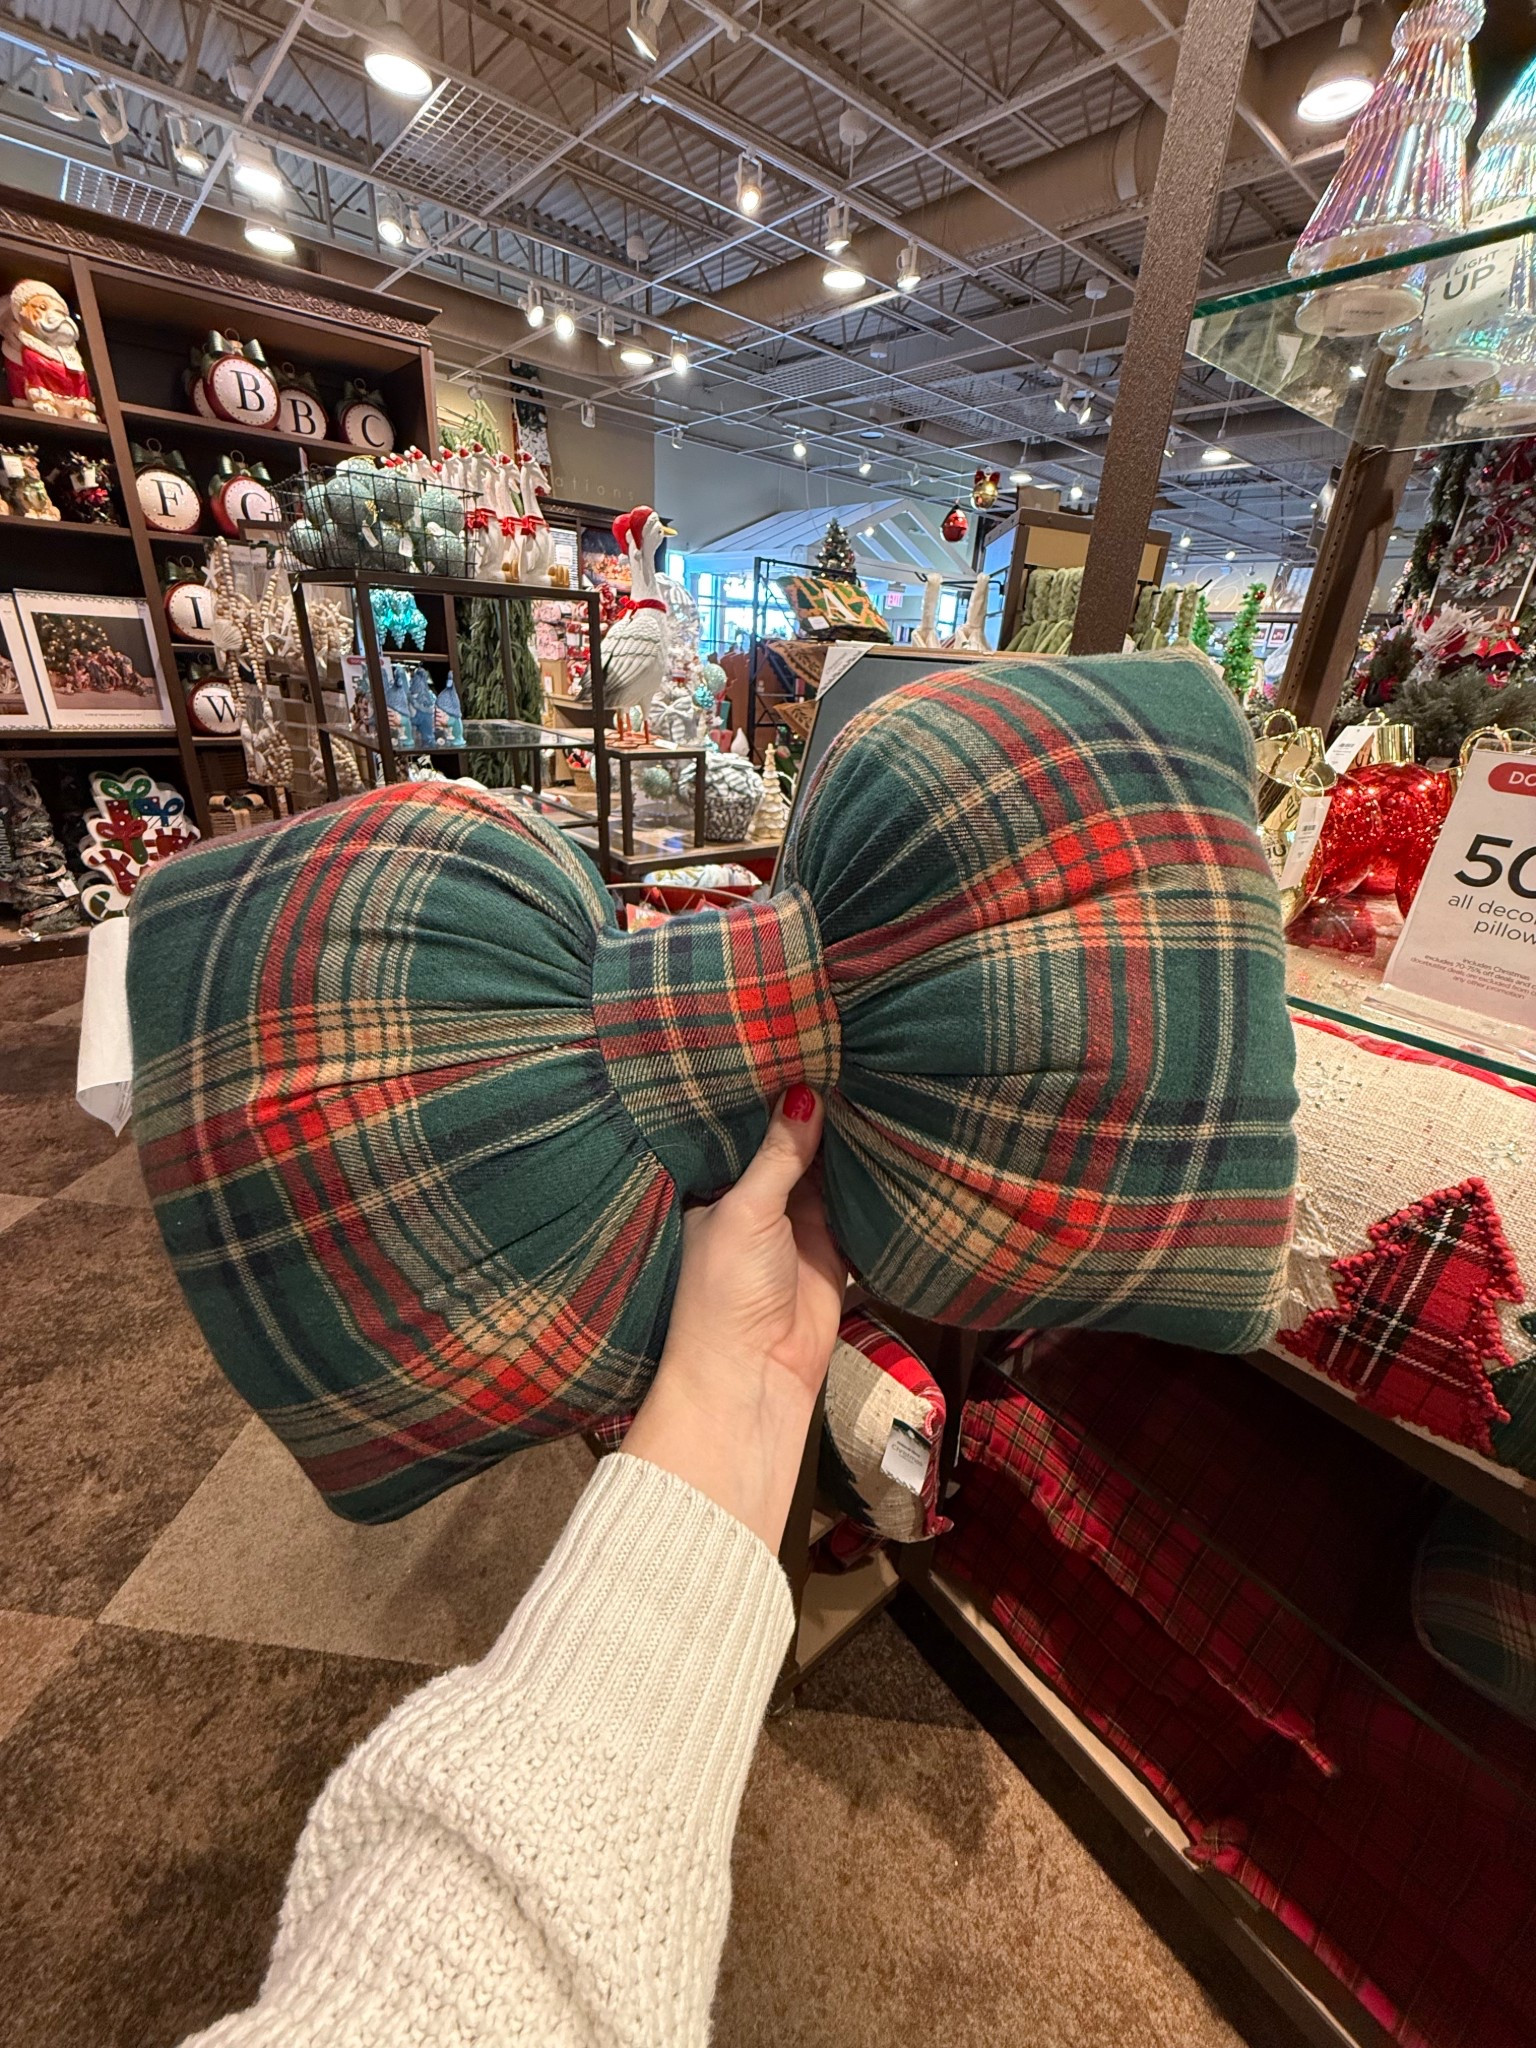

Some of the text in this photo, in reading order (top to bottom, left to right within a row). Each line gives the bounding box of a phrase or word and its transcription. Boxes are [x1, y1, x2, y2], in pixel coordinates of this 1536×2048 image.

[1454, 249, 1500, 275] LIGHT
[1443, 264, 1496, 300] UP
[230, 369, 265, 412] B
[287, 398, 316, 435] B
[361, 414, 386, 448] C
[150, 478, 185, 518] F
[240, 492, 274, 521] G
[184, 595, 211, 631] I
[822, 587, 862, 622] A
[201, 695, 237, 723] W
[1448, 894, 1474, 910] all
[1410, 956, 1447, 971] doorbuster
[1447, 967, 1466, 977] deals
[1478, 976, 1512, 989] excluded
[1512, 983, 1530, 994] from
[1424, 955, 1454, 967] excludes
[1455, 962, 1481, 975] 70-75%
[1482, 969, 1494, 977] off
[1494, 973, 1514, 984] deals
[1515, 979, 1531, 988] and
[1462, 958, 1530, 981] includes Christmas
[1452, 975, 1465, 984] any
[1466, 979, 1485, 989] other
[1486, 985, 1525, 1000] promotion
